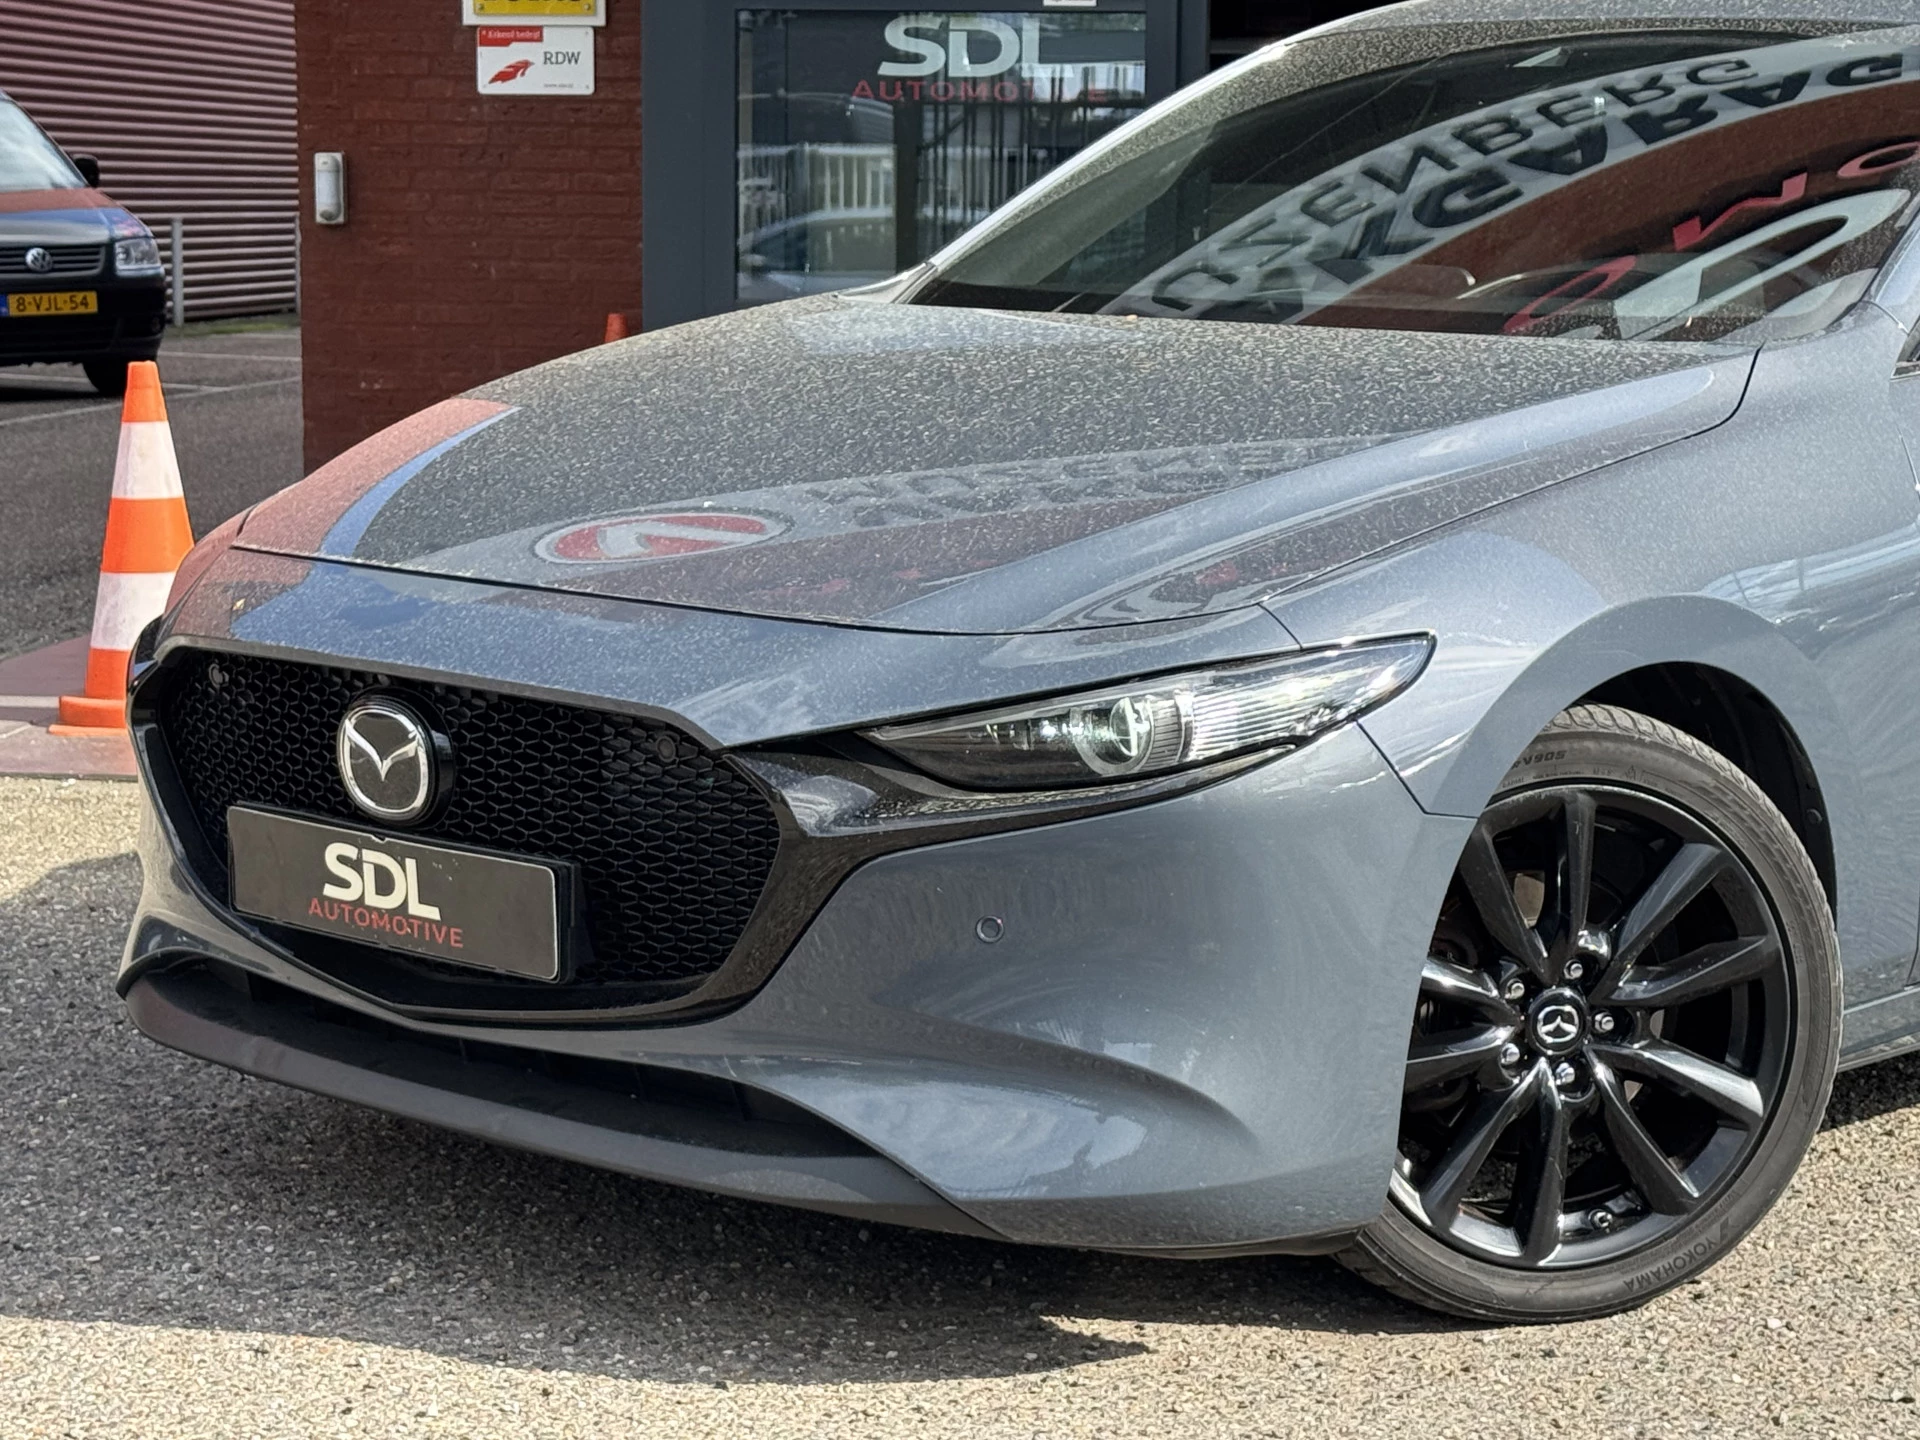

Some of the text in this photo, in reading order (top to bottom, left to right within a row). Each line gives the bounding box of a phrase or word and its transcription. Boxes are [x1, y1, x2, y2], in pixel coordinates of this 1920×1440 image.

[543, 51, 581, 65] RDW
[877, 15, 1074, 78] SDL
[852, 80, 1107, 103] AUTOMOTE
[15, 294, 90, 312] 8-VJL-54
[322, 842, 442, 921] SDL
[308, 897, 464, 948] AUTOMOTIVE
[1623, 1237, 1717, 1293] YOKOHAMA
